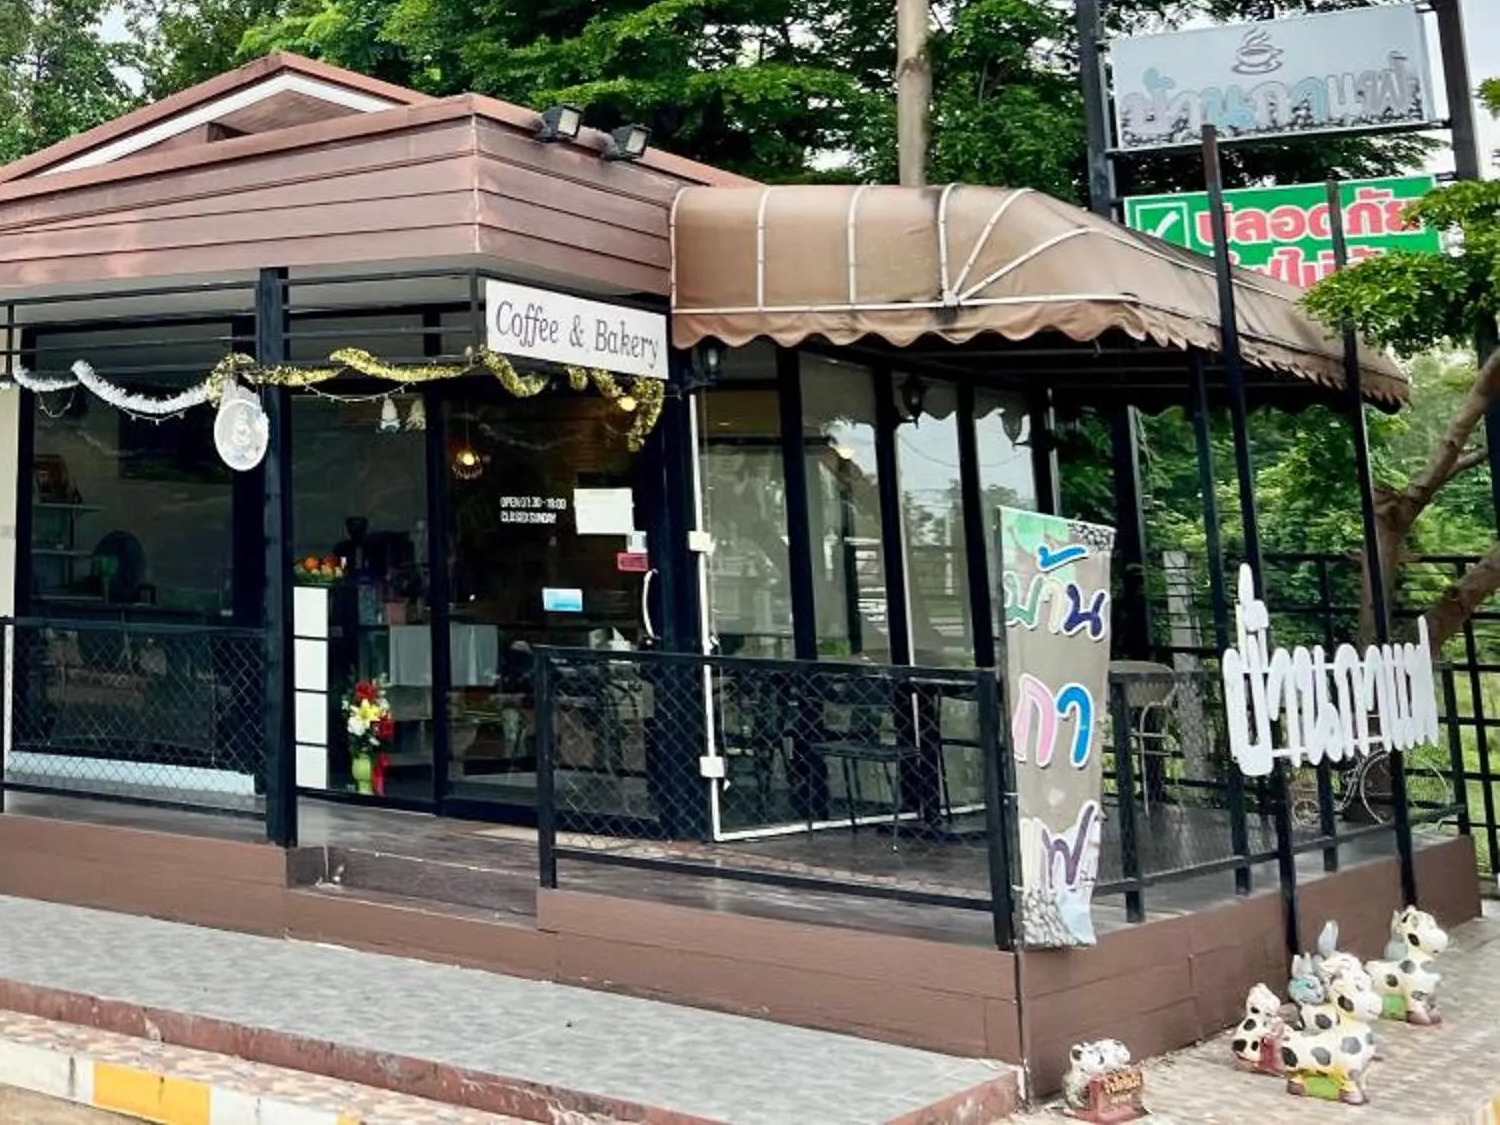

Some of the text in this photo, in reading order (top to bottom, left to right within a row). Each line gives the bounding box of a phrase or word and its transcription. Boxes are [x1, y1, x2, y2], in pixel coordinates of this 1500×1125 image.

[496, 300, 659, 370] Coffee & Bakery
[1002, 545, 1106, 641] บ้าน
[1011, 672, 1093, 768] กา
